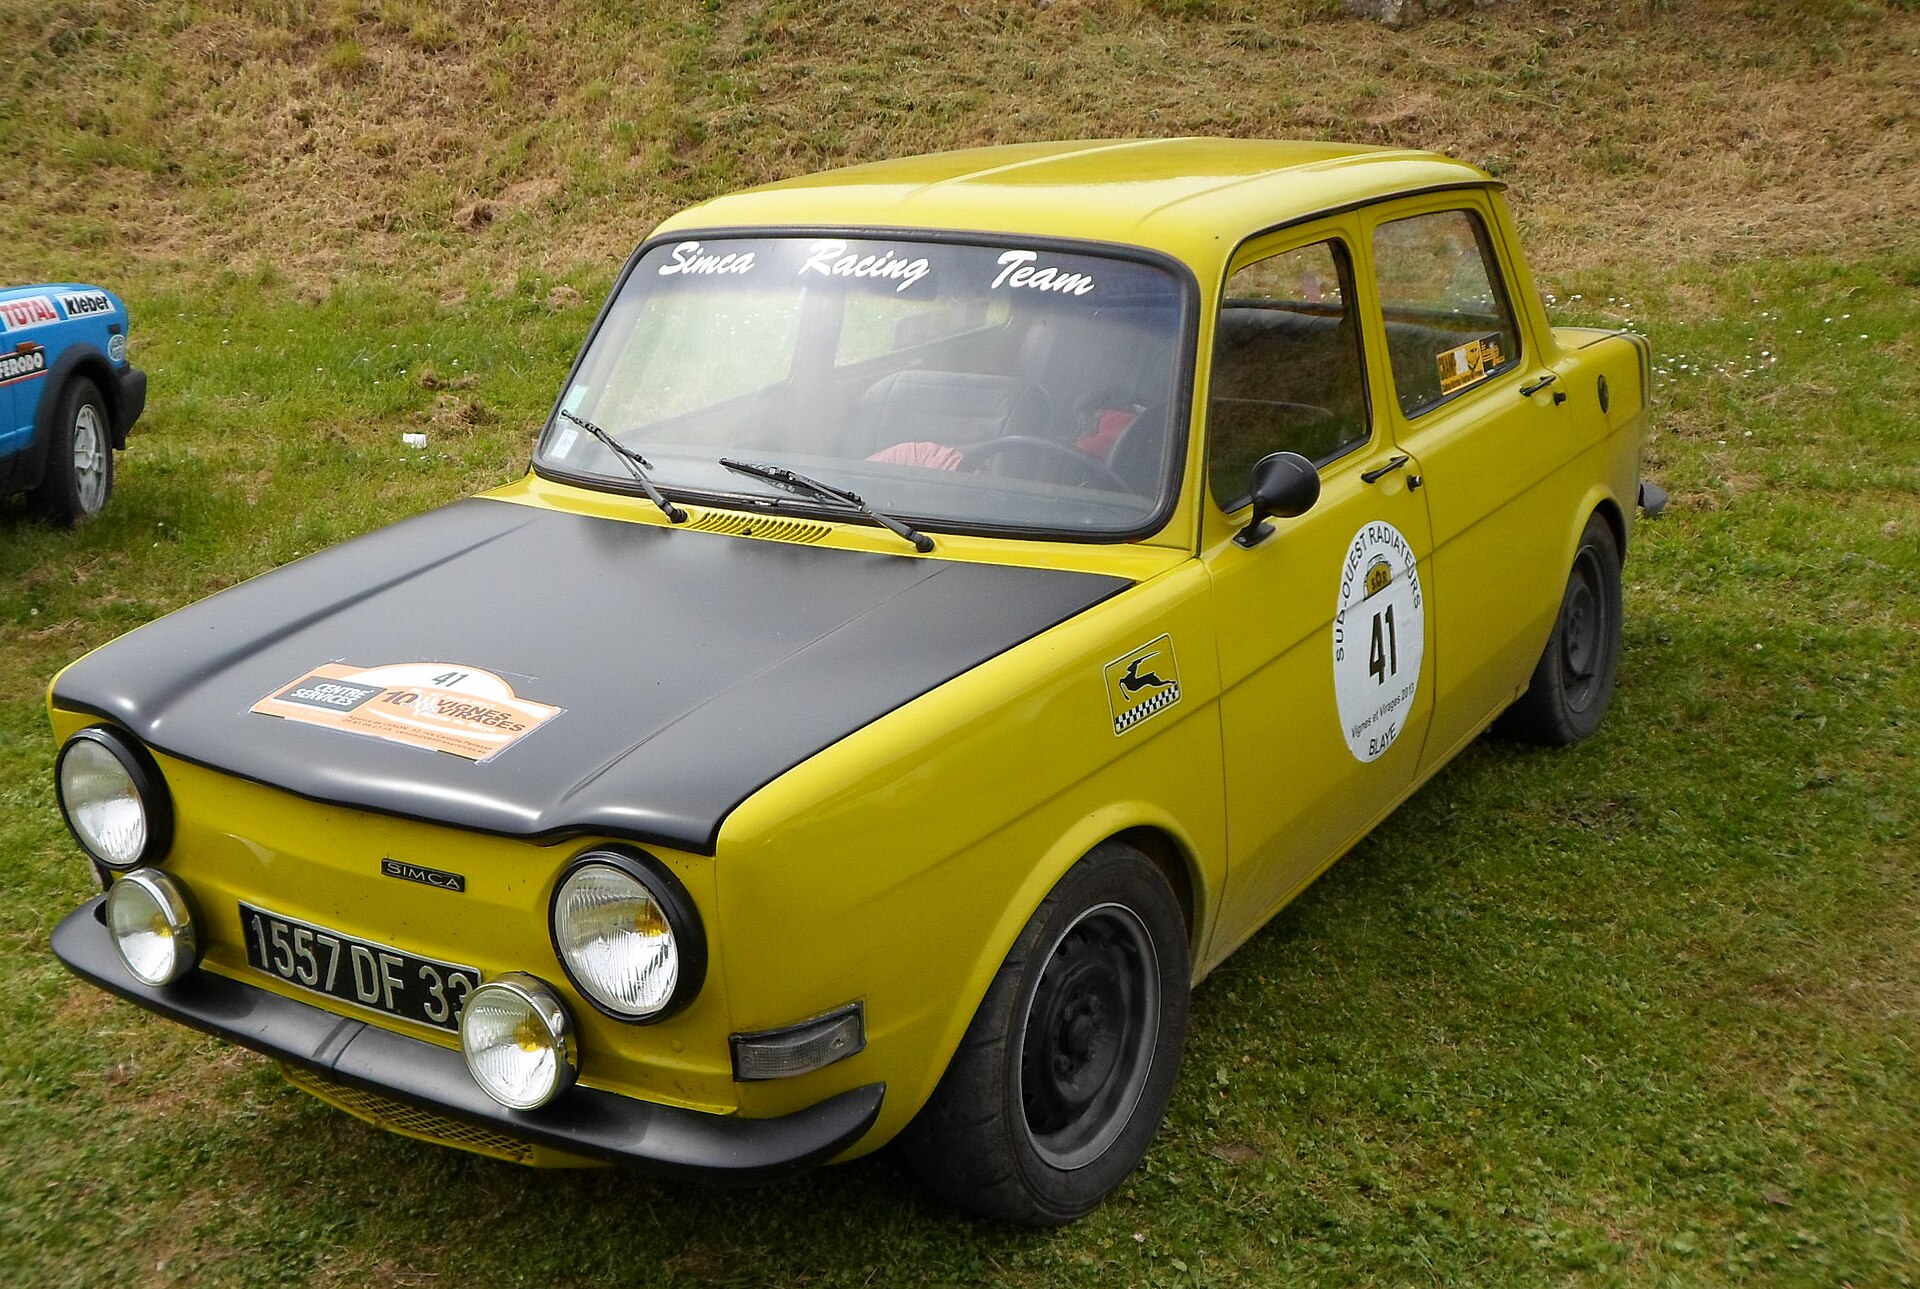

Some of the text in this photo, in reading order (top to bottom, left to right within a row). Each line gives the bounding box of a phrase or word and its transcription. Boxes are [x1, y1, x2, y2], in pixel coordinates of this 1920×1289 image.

[658, 239, 1095, 296] Simca Racing Team
[0, 300, 56, 327] TOTAL
[1369, 526, 1420, 609] RADIATEURS
[1369, 604, 1397, 686] 41
[314, 683, 369, 699] CENTRE
[432, 671, 469, 687] 41
[291, 688, 357, 706] SERVICES
[437, 699, 512, 720] VIGNES
[437, 707, 526, 732] VIRAGES
[1368, 722, 1396, 756] BLAYE
[386, 862, 460, 890] SIMCA
[250, 914, 340, 993] 1557
[350, 944, 404, 1010] DF
